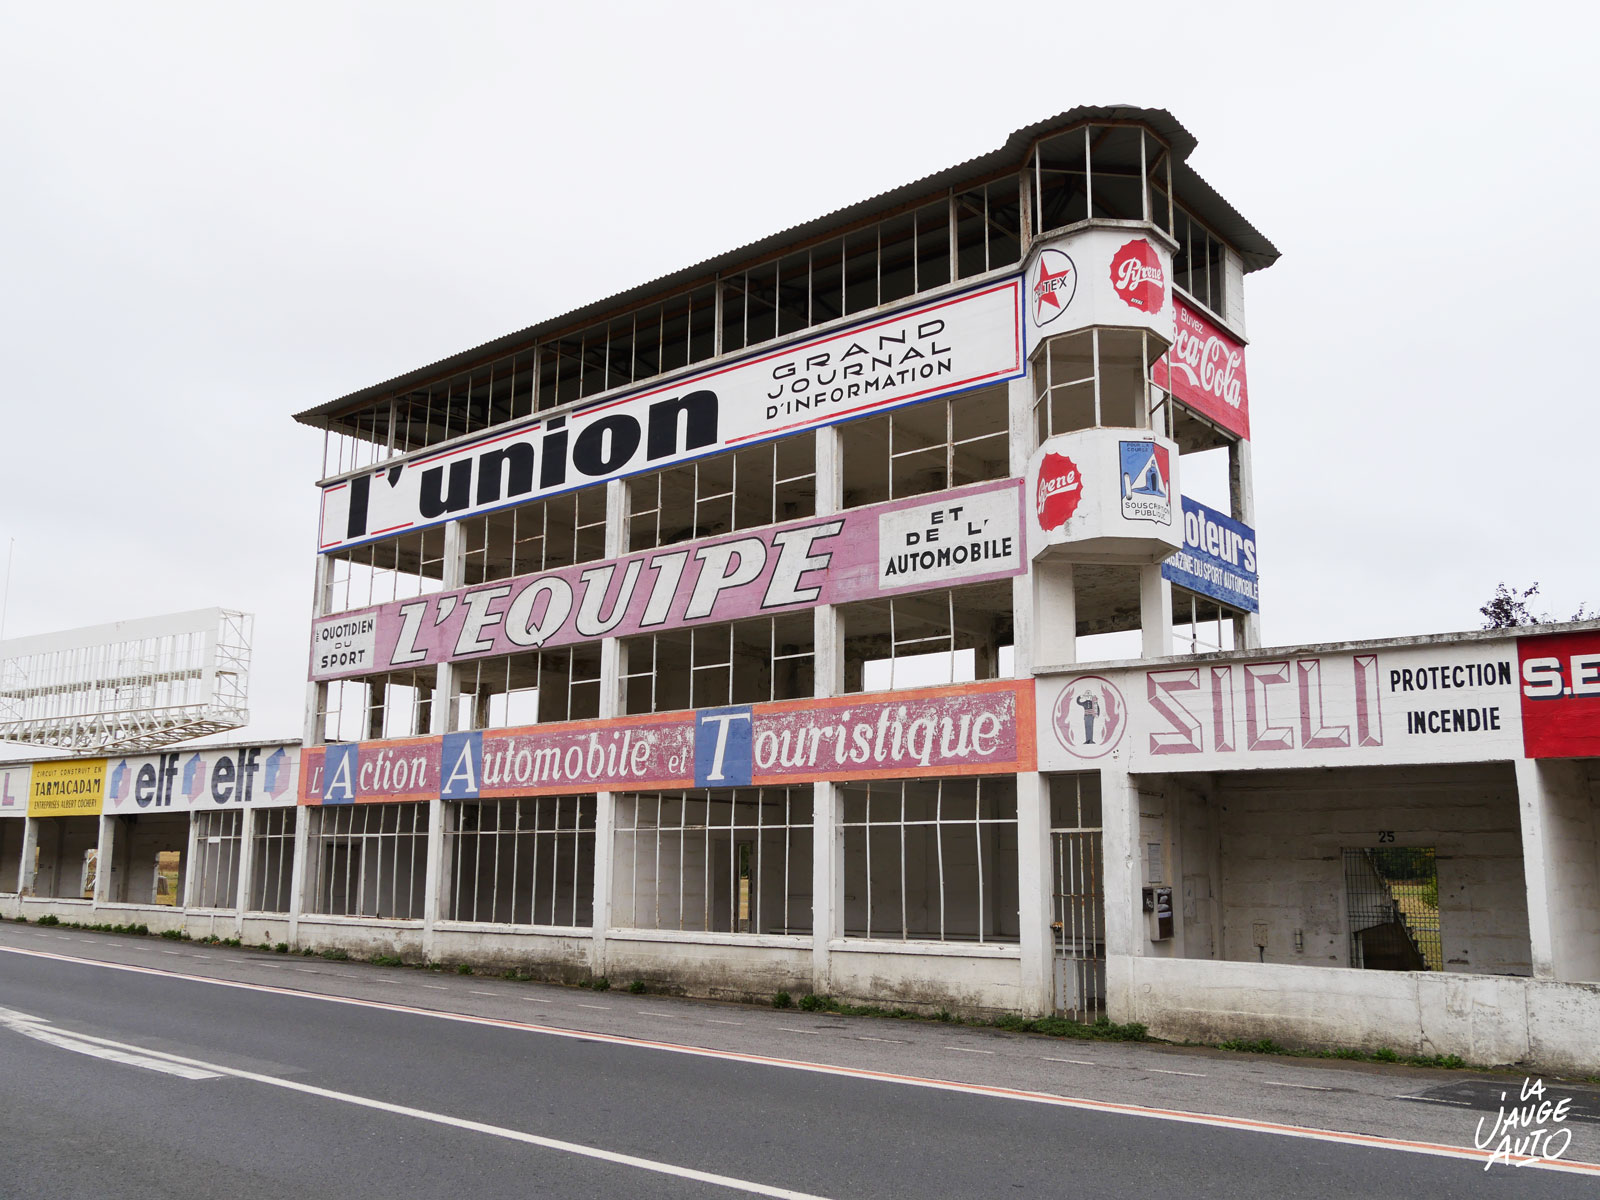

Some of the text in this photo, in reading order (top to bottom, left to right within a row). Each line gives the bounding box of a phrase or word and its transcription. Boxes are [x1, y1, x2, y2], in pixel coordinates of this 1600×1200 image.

[1181, 308, 1203, 334] Buvez
[772, 319, 945, 380] GRAND
[767, 341, 951, 399] JOURNAL
[766, 358, 951, 420] D'INFORMATION
[931, 506, 963, 525] ET
[906, 528, 939, 546] DE
[1183, 509, 1256, 573] oteurs
[885, 536, 1012, 577] AUTOMOBILE
[1204, 563, 1223, 587] SPORT
[389, 518, 846, 666] L'EQUIPE
[322, 618, 374, 641] QUOTIDIEN
[321, 649, 365, 669] SPORT
[335, 640, 352, 649] DU
[1390, 661, 1512, 692] PROTECTION
[1147, 654, 1384, 756] SICLI
[1407, 707, 1501, 735] INCENDIE
[442, 729, 651, 794] Automobile
[668, 743, 689, 774] et
[701, 705, 1001, 781] Touristique
[37, 766, 102, 778] CIRCUIT CONSTRUIT EN
[135, 753, 180, 808] elf
[211, 748, 262, 804] elf
[35, 779, 101, 796] TARMACADAM
[1378, 831, 1395, 843] 25
